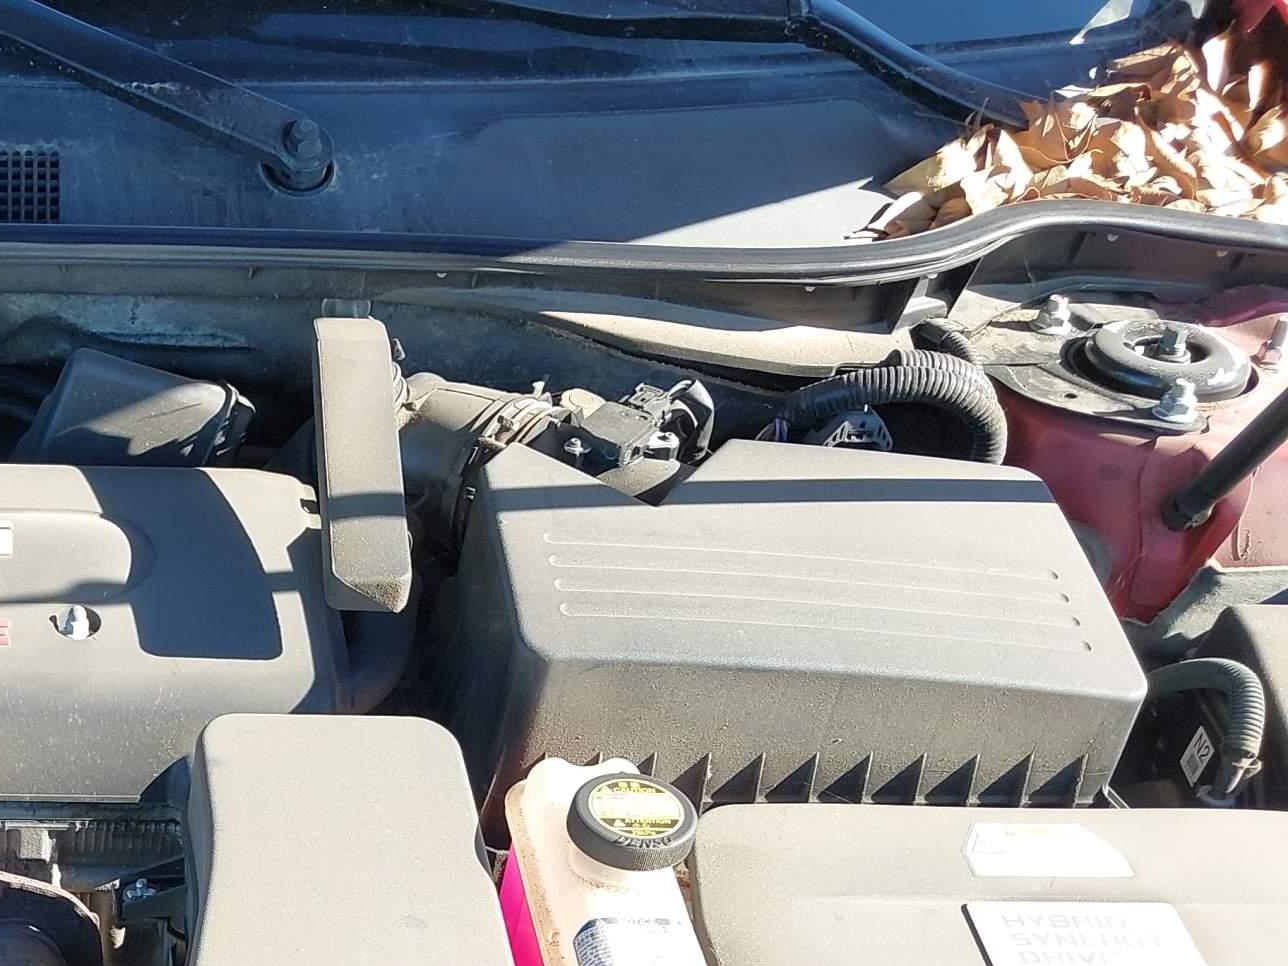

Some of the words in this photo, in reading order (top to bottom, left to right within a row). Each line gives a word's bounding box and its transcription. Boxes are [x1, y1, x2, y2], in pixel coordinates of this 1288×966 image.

[1193, 732, 1210, 764] N2
[614, 836, 672, 848] DENSO
[1000, 914, 1128, 929] HYBRID
